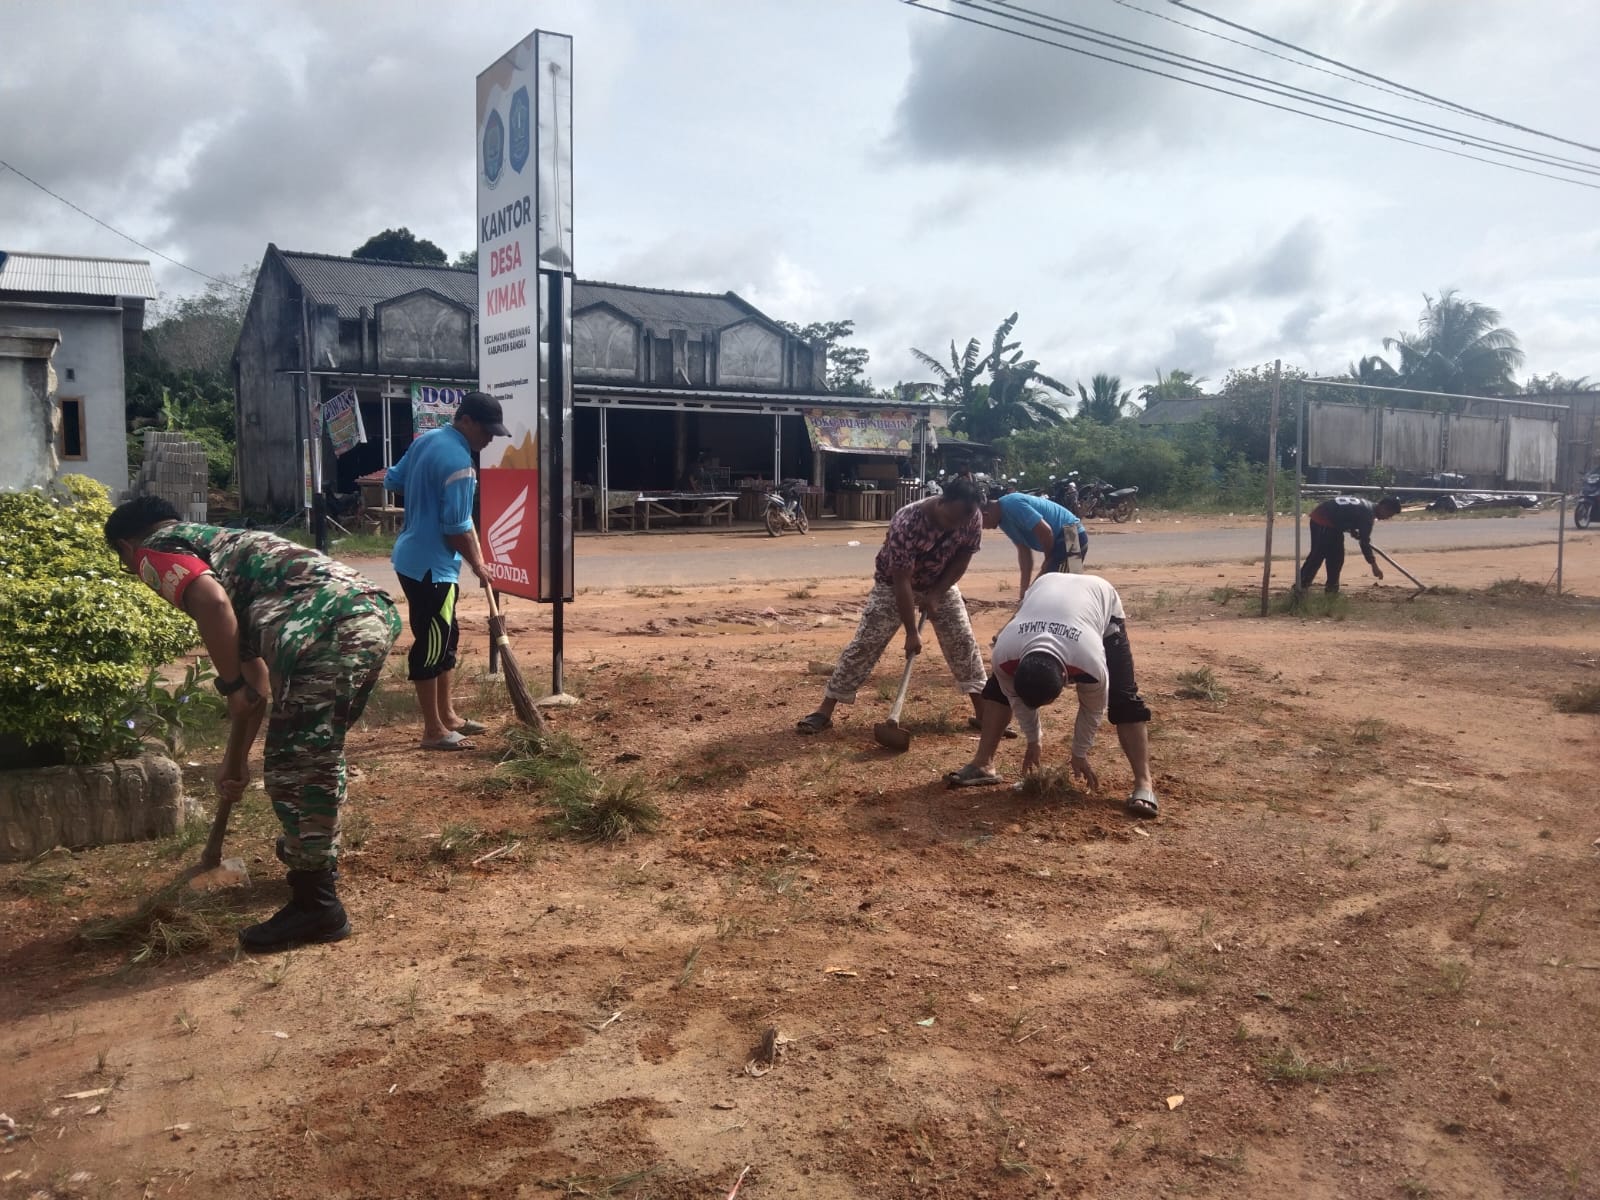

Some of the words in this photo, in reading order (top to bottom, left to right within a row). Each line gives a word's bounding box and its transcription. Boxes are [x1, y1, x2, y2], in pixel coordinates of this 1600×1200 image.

[481, 195, 532, 244] KANTOR
[490, 241, 522, 278] DESA
[487, 278, 526, 317] KIMAK
[487, 343, 510, 356] KABUPATEN
[487, 562, 530, 584] HONDA
[1048, 622, 1082, 641] PEMDES
